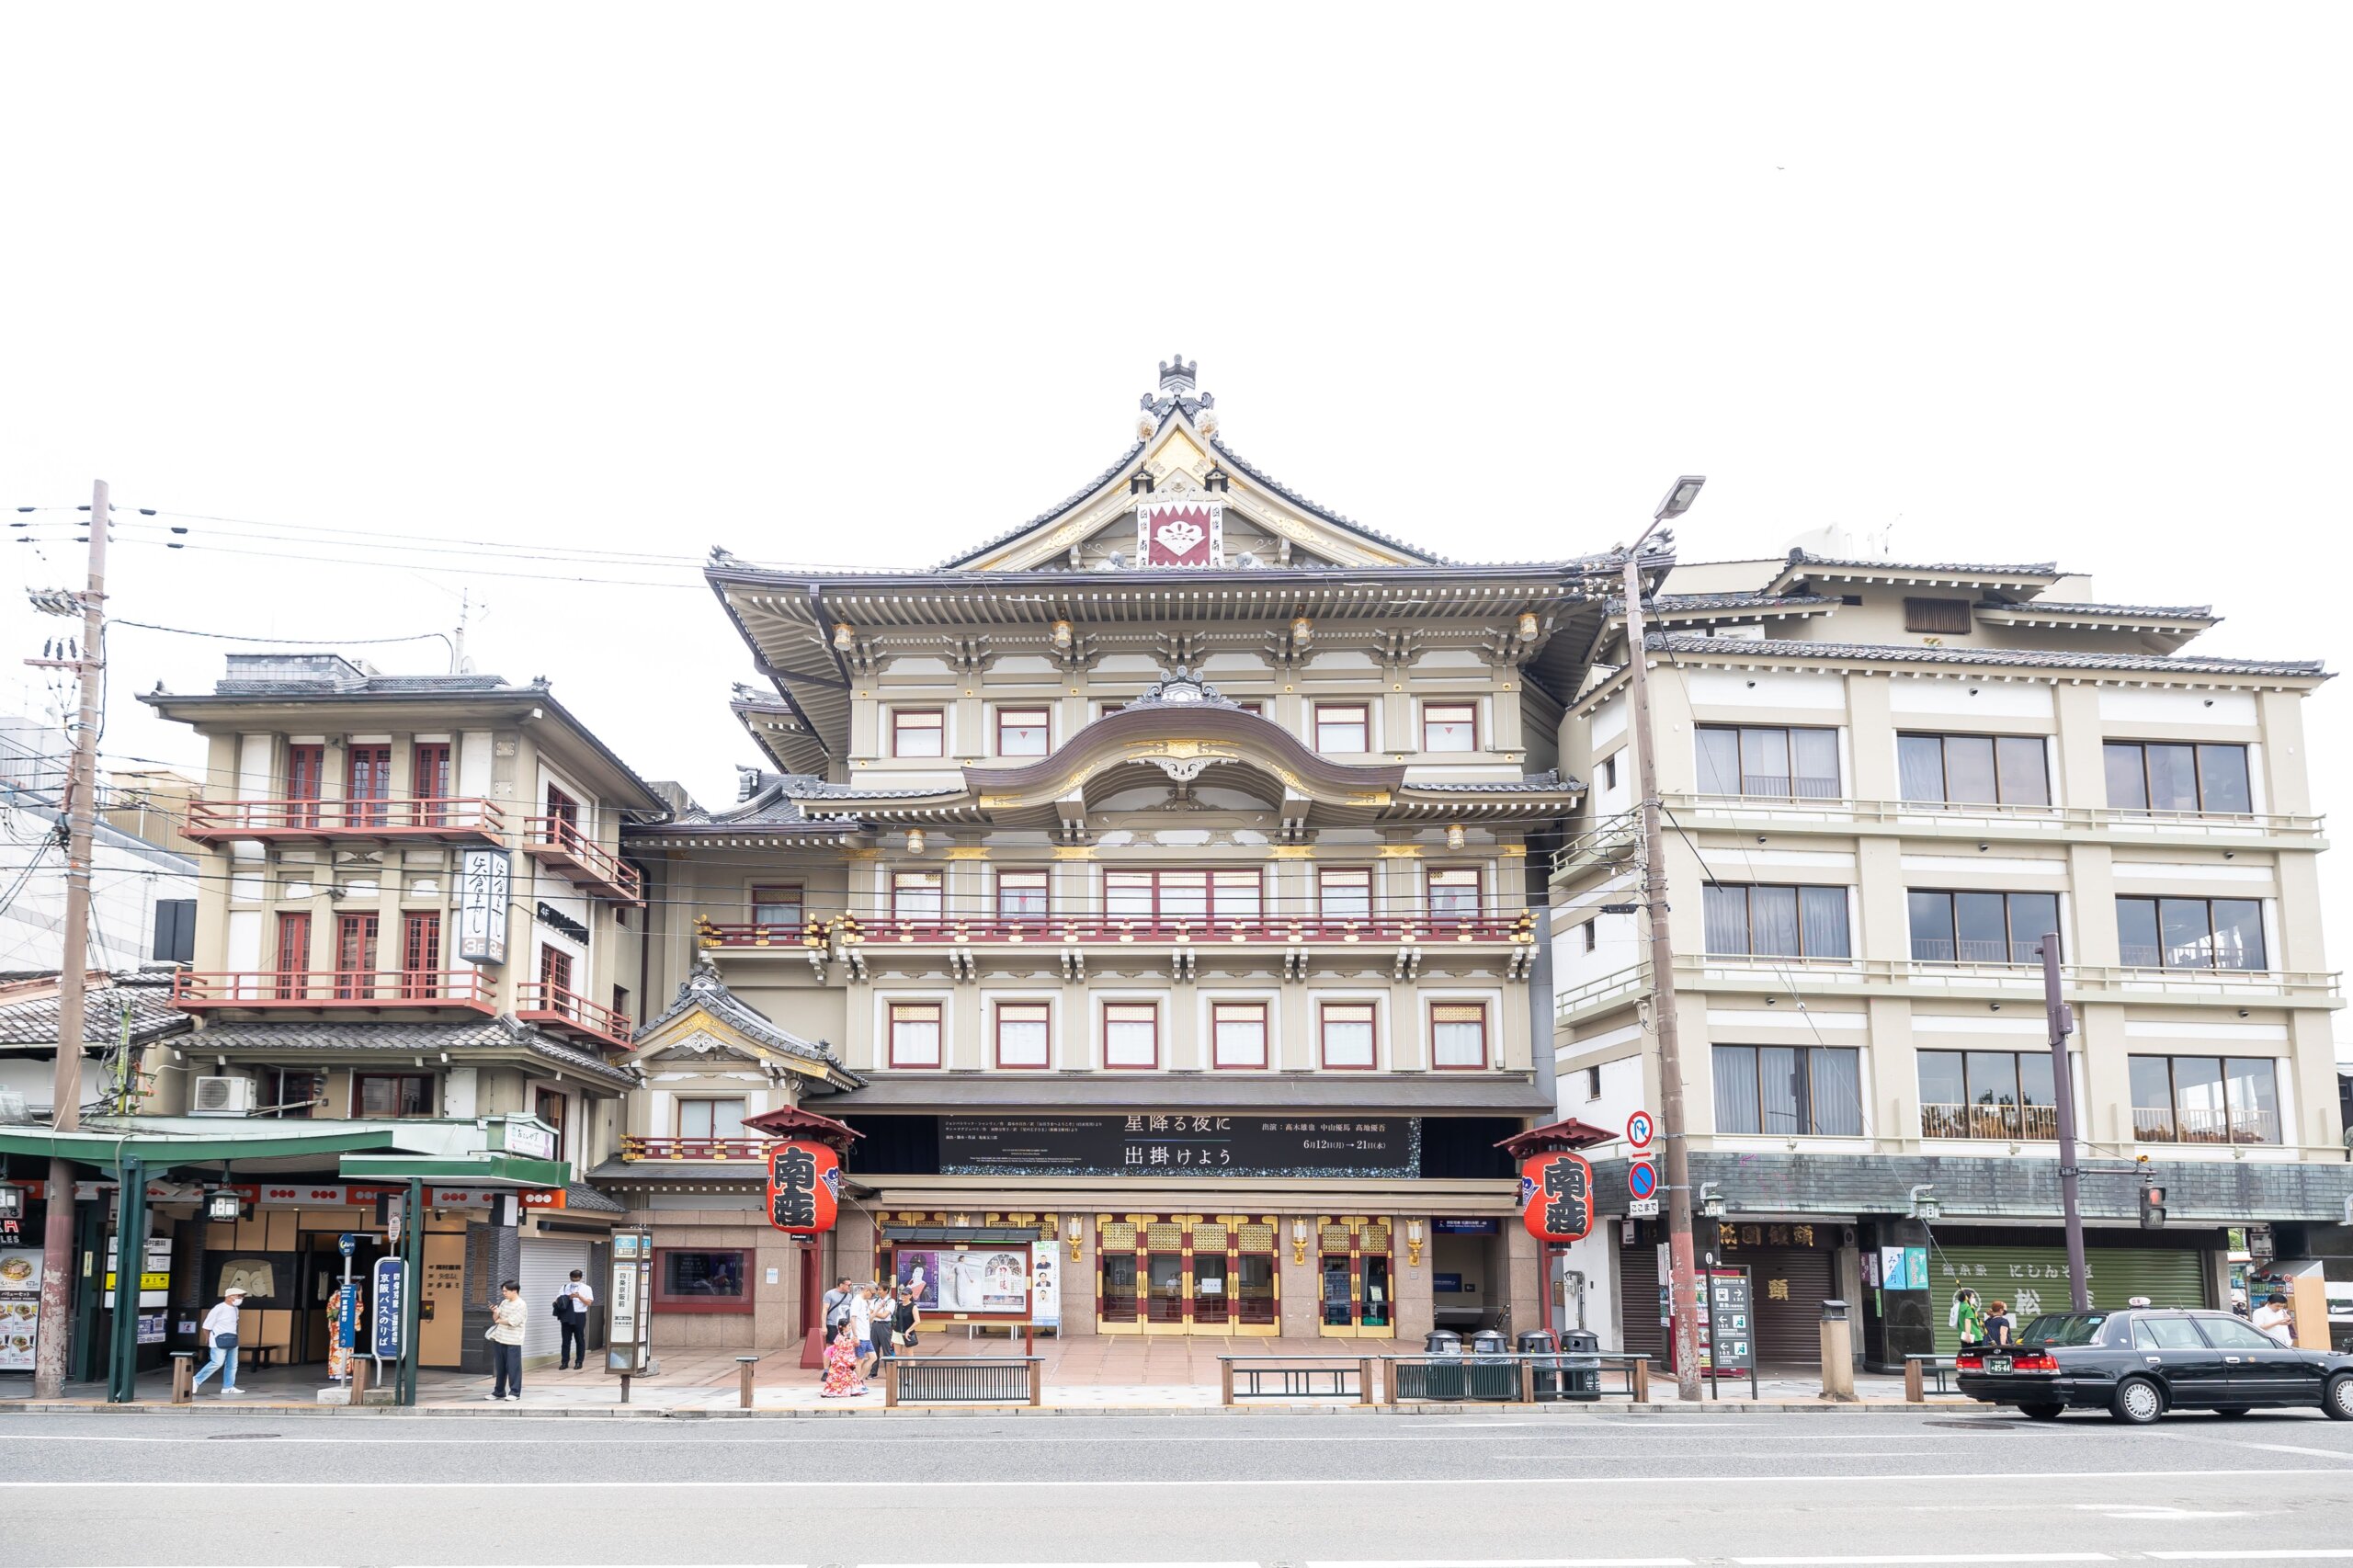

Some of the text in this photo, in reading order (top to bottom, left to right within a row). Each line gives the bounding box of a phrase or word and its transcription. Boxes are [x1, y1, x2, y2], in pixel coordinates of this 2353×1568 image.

[540, 907, 550, 917] 4F
[464, 938, 485, 953] 3F
[489, 940, 502, 958] 3F
[1124, 1115, 1231, 1131] 星降る夜に
[1320, 1123, 1350, 1131] 中山優馬
[1125, 1146, 1230, 1165] 出掛けよう
[773, 1146, 816, 1228] 南座
[1543, 1157, 1587, 1235] 南座
[1631, 1203, 1656, 1212] ここまで
[379, 1273, 390, 1346] 京阪バスのりば
